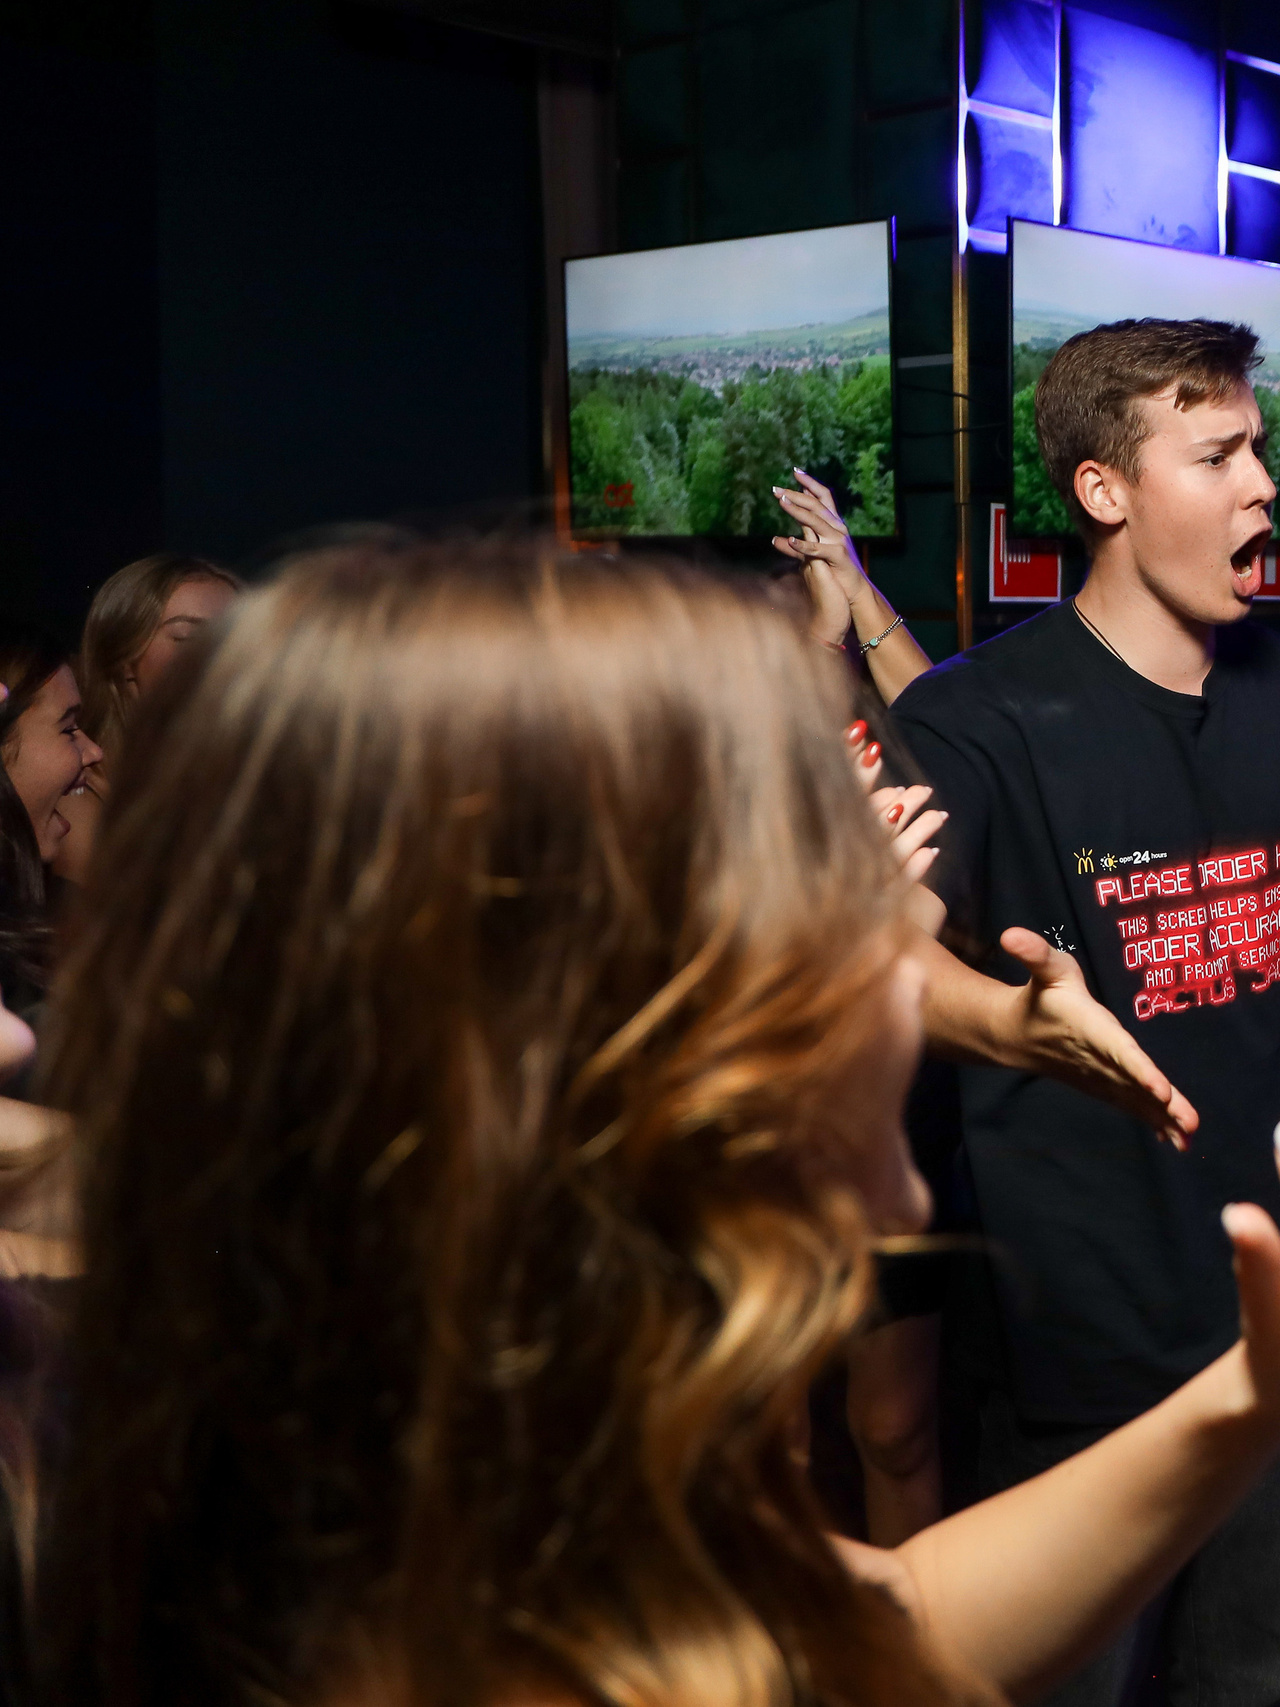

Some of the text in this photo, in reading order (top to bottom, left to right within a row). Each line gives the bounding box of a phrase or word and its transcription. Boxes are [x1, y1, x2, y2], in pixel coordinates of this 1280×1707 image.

[1119, 850, 1167, 865] open 24 hours
[1098, 867, 1192, 905] PLEASE
[1118, 916, 1148, 938] THIS
[1157, 907, 1207, 931] SCREE
[1209, 895, 1258, 920] HELPS
[1125, 933, 1201, 968] ORDER
[1146, 967, 1174, 988] AND
